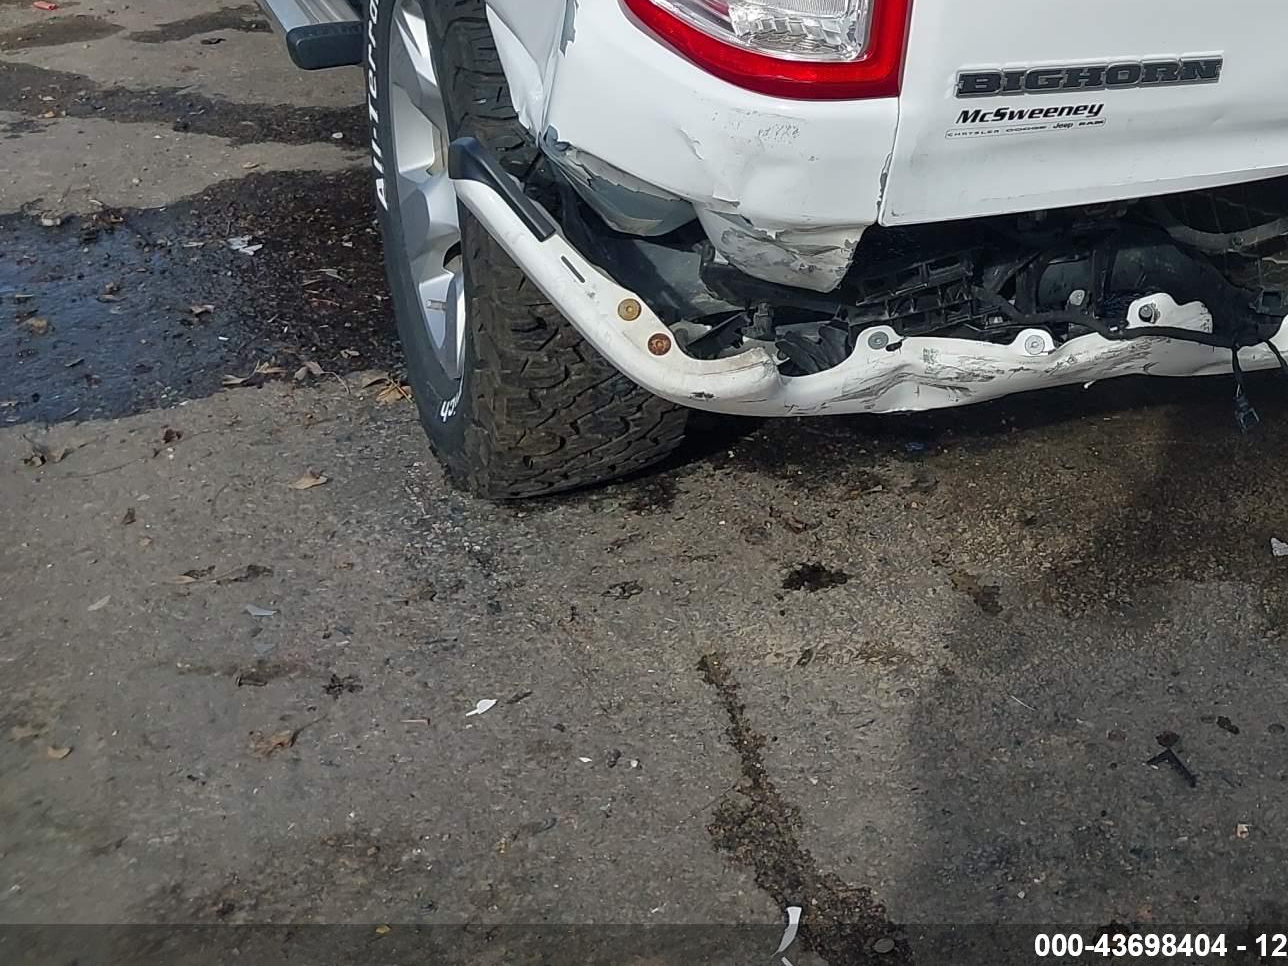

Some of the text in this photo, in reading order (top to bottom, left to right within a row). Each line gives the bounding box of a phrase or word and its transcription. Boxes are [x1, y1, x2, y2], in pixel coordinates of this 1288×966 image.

[954, 55, 1223, 98] BIGHORN
[955, 103, 1105, 125] McSweeney
[1052, 122, 1074, 130] Jeep
